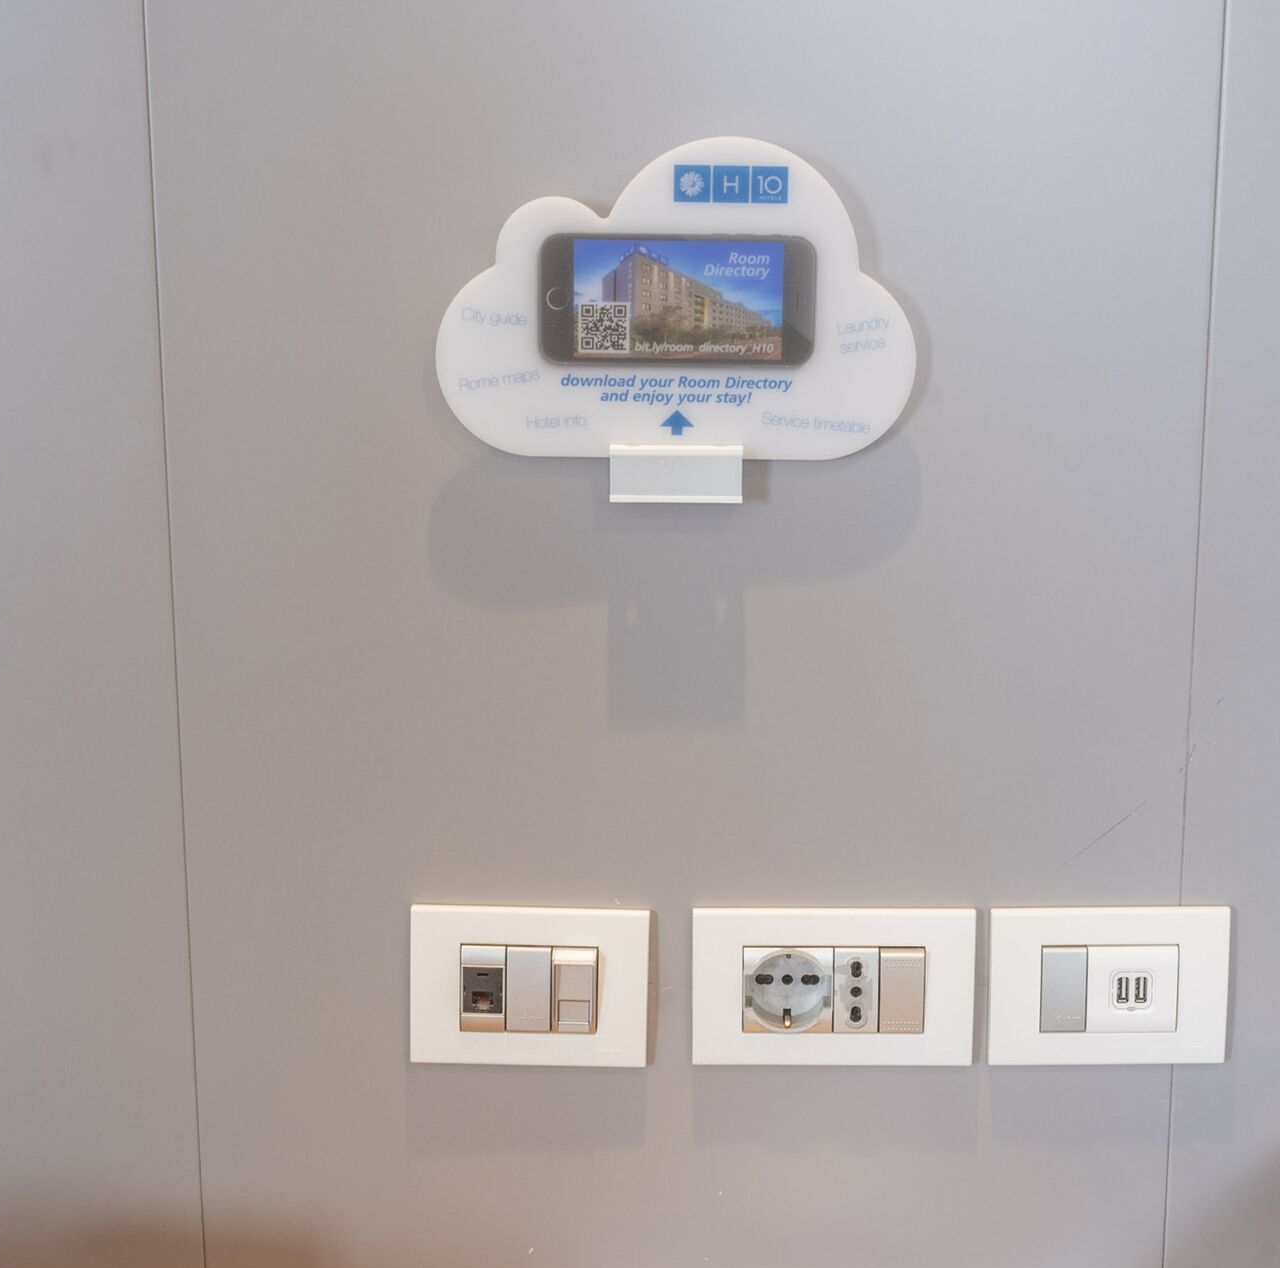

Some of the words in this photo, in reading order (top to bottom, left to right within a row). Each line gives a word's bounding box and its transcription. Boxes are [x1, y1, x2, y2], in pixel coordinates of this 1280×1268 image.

[723, 175, 740, 194] H
[758, 174, 783, 195] 10
[728, 252, 770, 265] Room
[703, 264, 770, 280] Directory
[461, 307, 488, 325] City
[489, 310, 528, 327] guide
[836, 315, 890, 336] Laundry
[839, 337, 887, 355] service
[458, 373, 500, 392] Rome
[502, 369, 541, 387] maps
[560, 374, 635, 388] download
[638, 377, 675, 391] your
[678, 376, 720, 389] Room
[724, 376, 793, 392] Directory
[600, 390, 630, 402] and
[632, 391, 673, 406] enjoy
[676, 392, 712, 406] your
[715, 392, 752, 407] stay!
[526, 415, 561, 429] Hotel
[563, 414, 588, 428] info
[761, 411, 810, 430] Service
[813, 415, 871, 435] timetable
